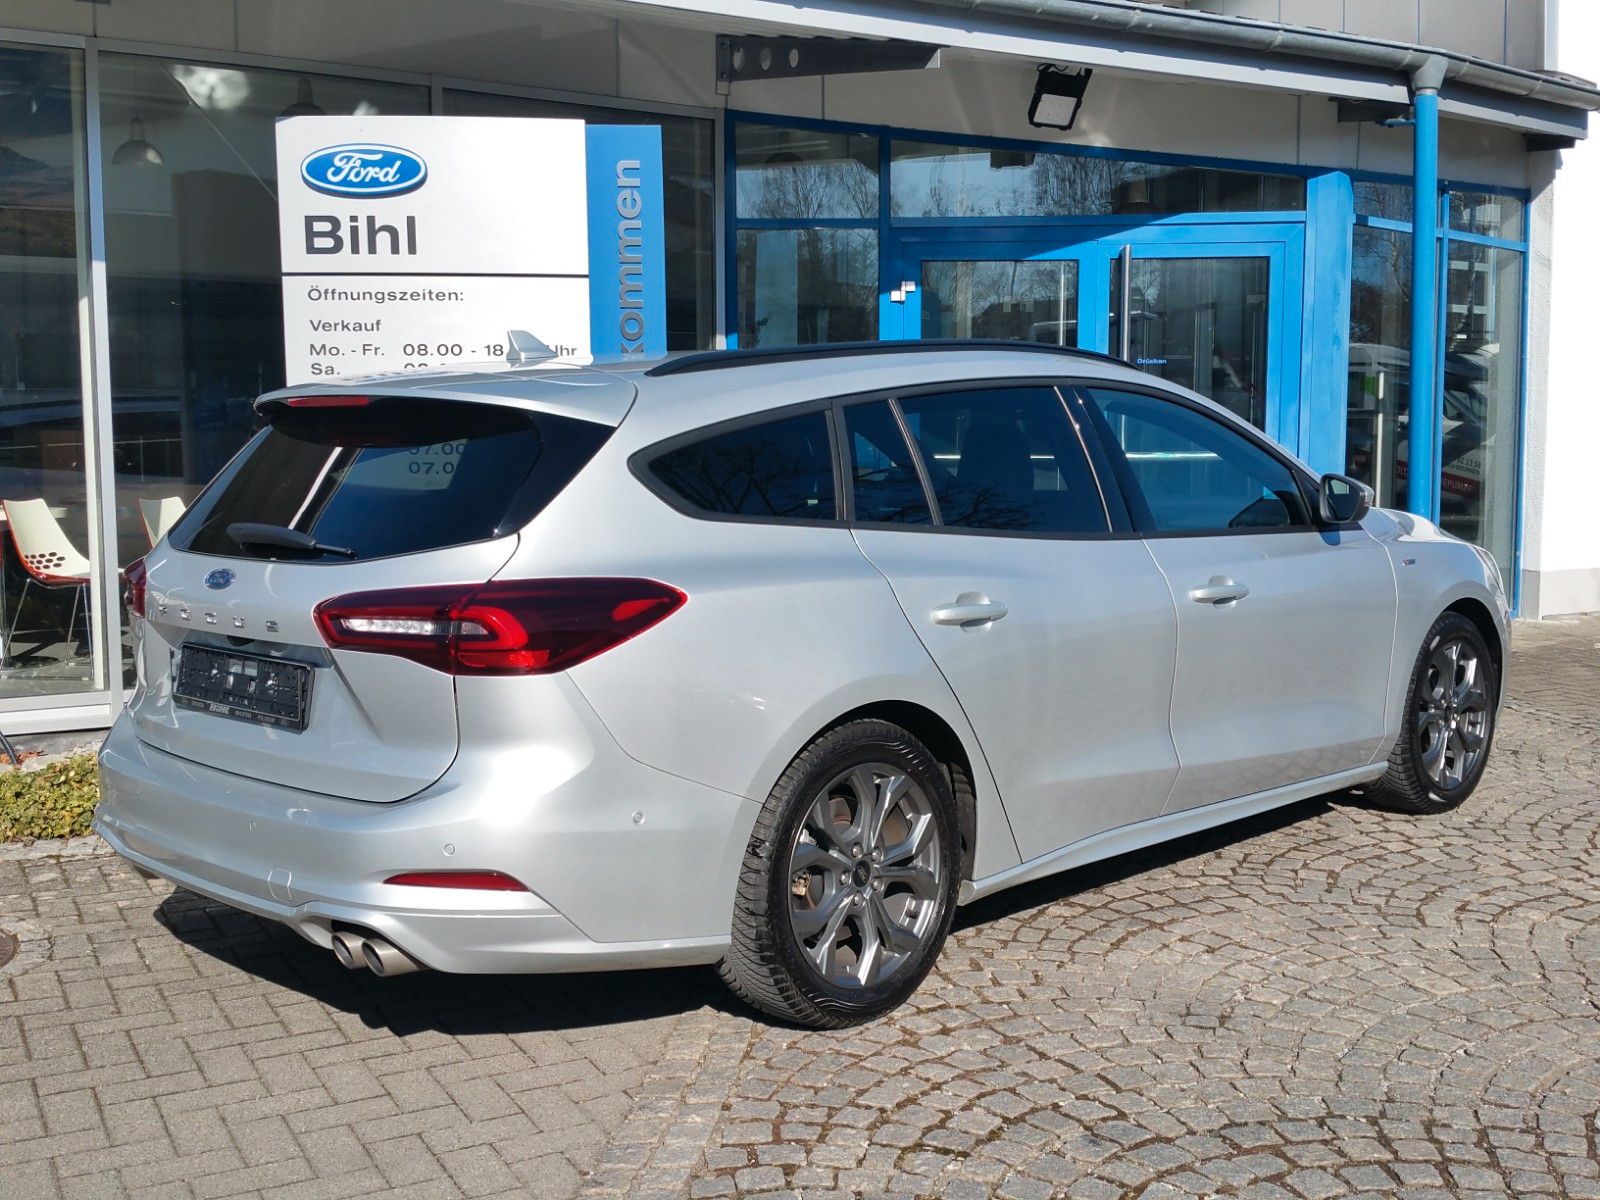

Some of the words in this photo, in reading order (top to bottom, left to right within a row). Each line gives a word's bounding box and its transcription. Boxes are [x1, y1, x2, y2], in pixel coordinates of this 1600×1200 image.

[326, 152, 402, 183] Ford
[304, 215, 417, 255] Bihl
[307, 284, 464, 304] Öffnungszeiten:
[309, 319, 382, 332] Verkauf
[309, 343, 346, 356] Mo.
[361, 343, 385, 356] Fr.
[402, 343, 463, 357] 08.00
[310, 362, 341, 376] Sa.
